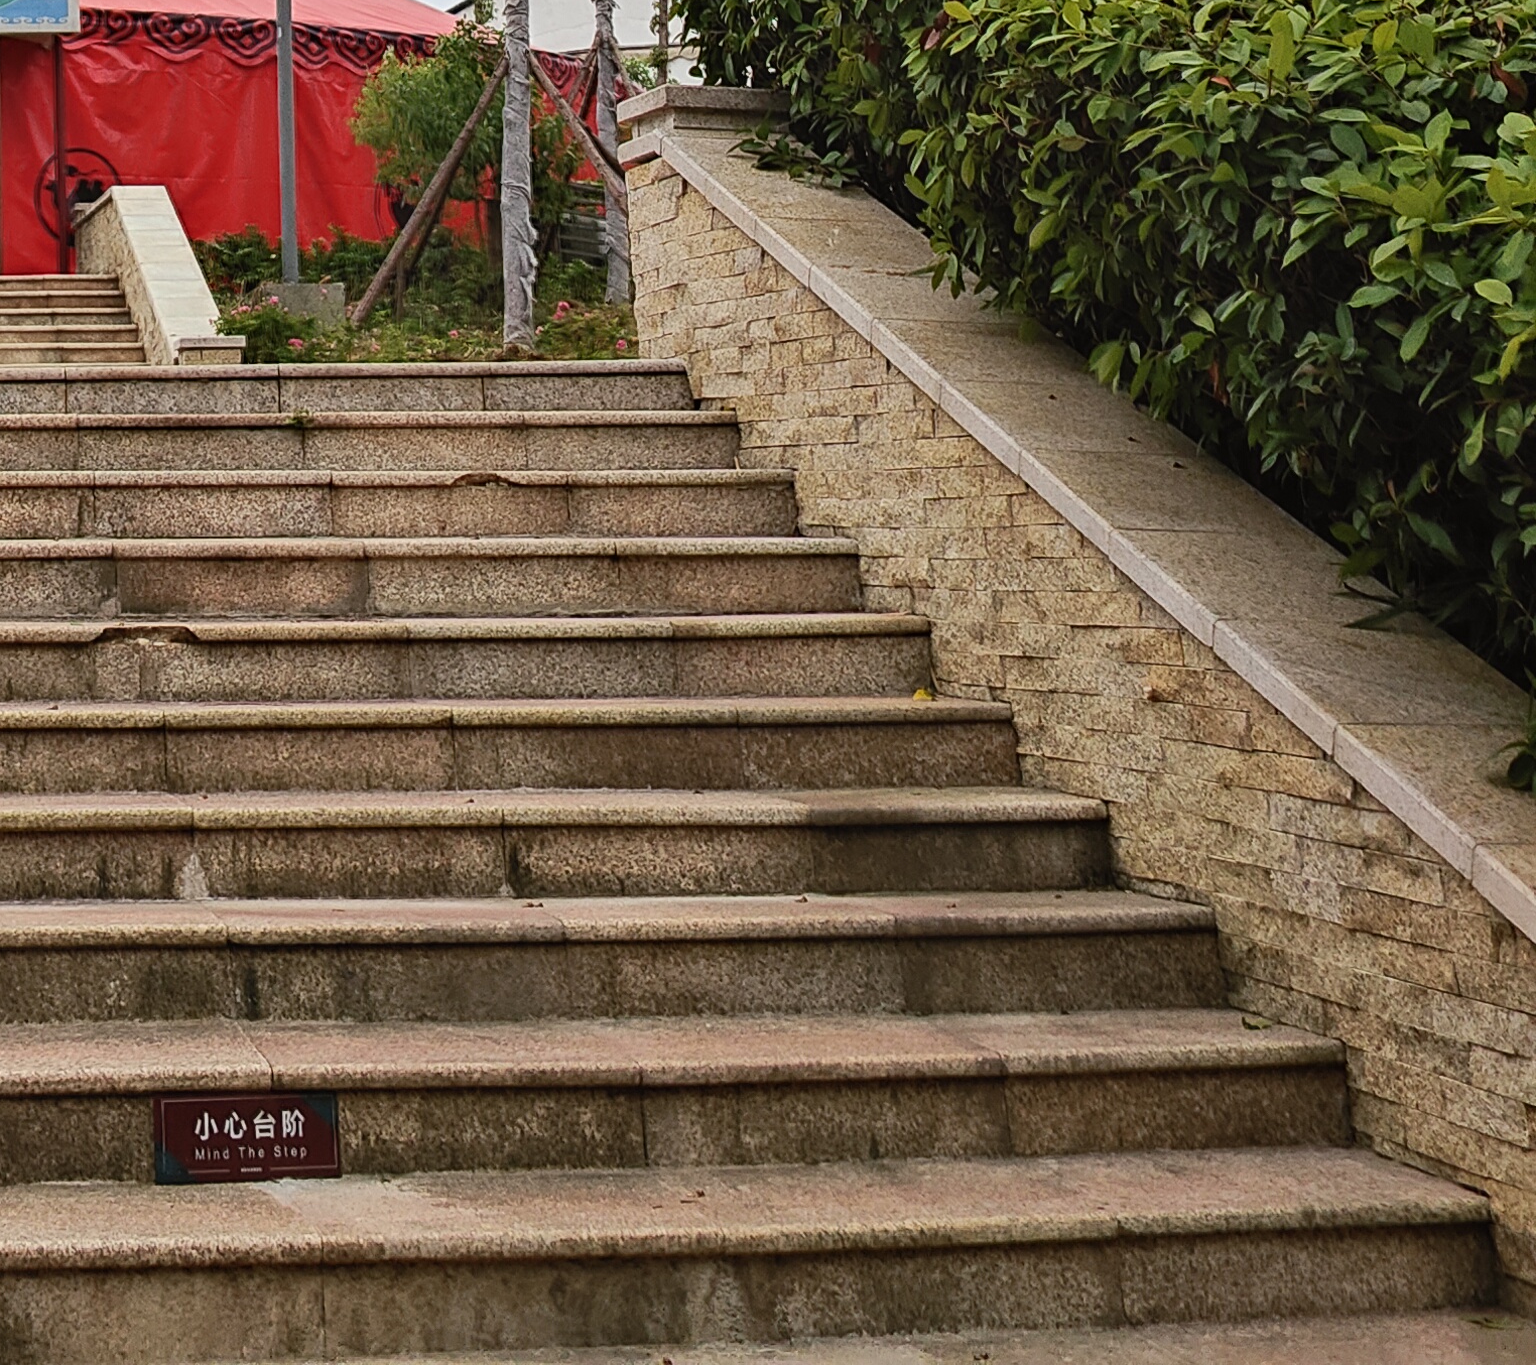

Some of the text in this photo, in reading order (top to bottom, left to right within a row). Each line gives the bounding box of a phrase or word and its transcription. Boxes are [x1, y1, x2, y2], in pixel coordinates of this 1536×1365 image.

[194, 1109, 305, 1141] 小心台阶
[195, 1144, 308, 1161] Mind The Step
